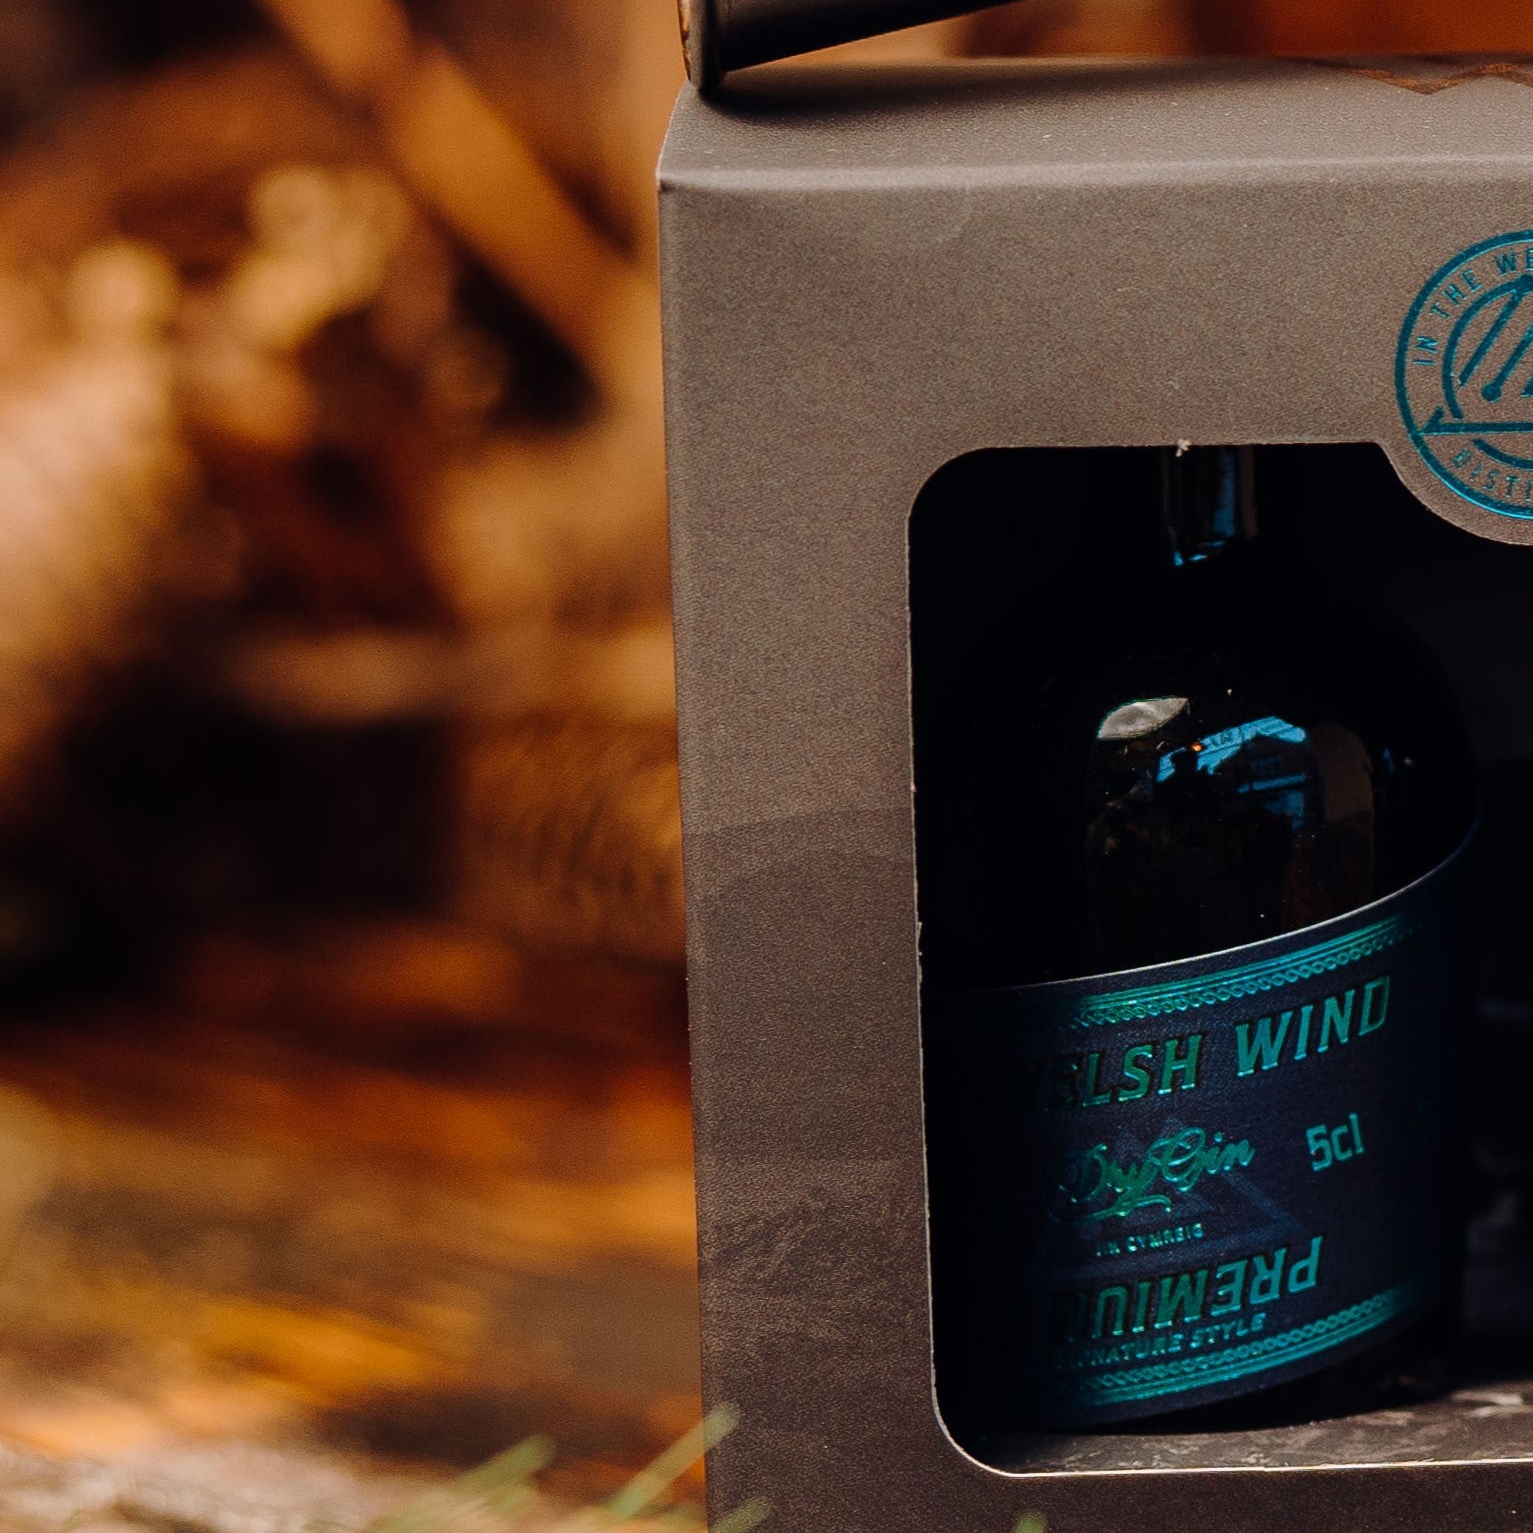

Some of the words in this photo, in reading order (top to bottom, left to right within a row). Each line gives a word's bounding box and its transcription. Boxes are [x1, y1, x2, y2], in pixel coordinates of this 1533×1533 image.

[1413, 336, 1438, 366] IN
[1430, 269, 1482, 319] THE
[1234, 975, 1391, 1078] WIND
[1305, 1113, 1365, 1172] 5cl
[1189, 1311, 1268, 1349] STYLE
